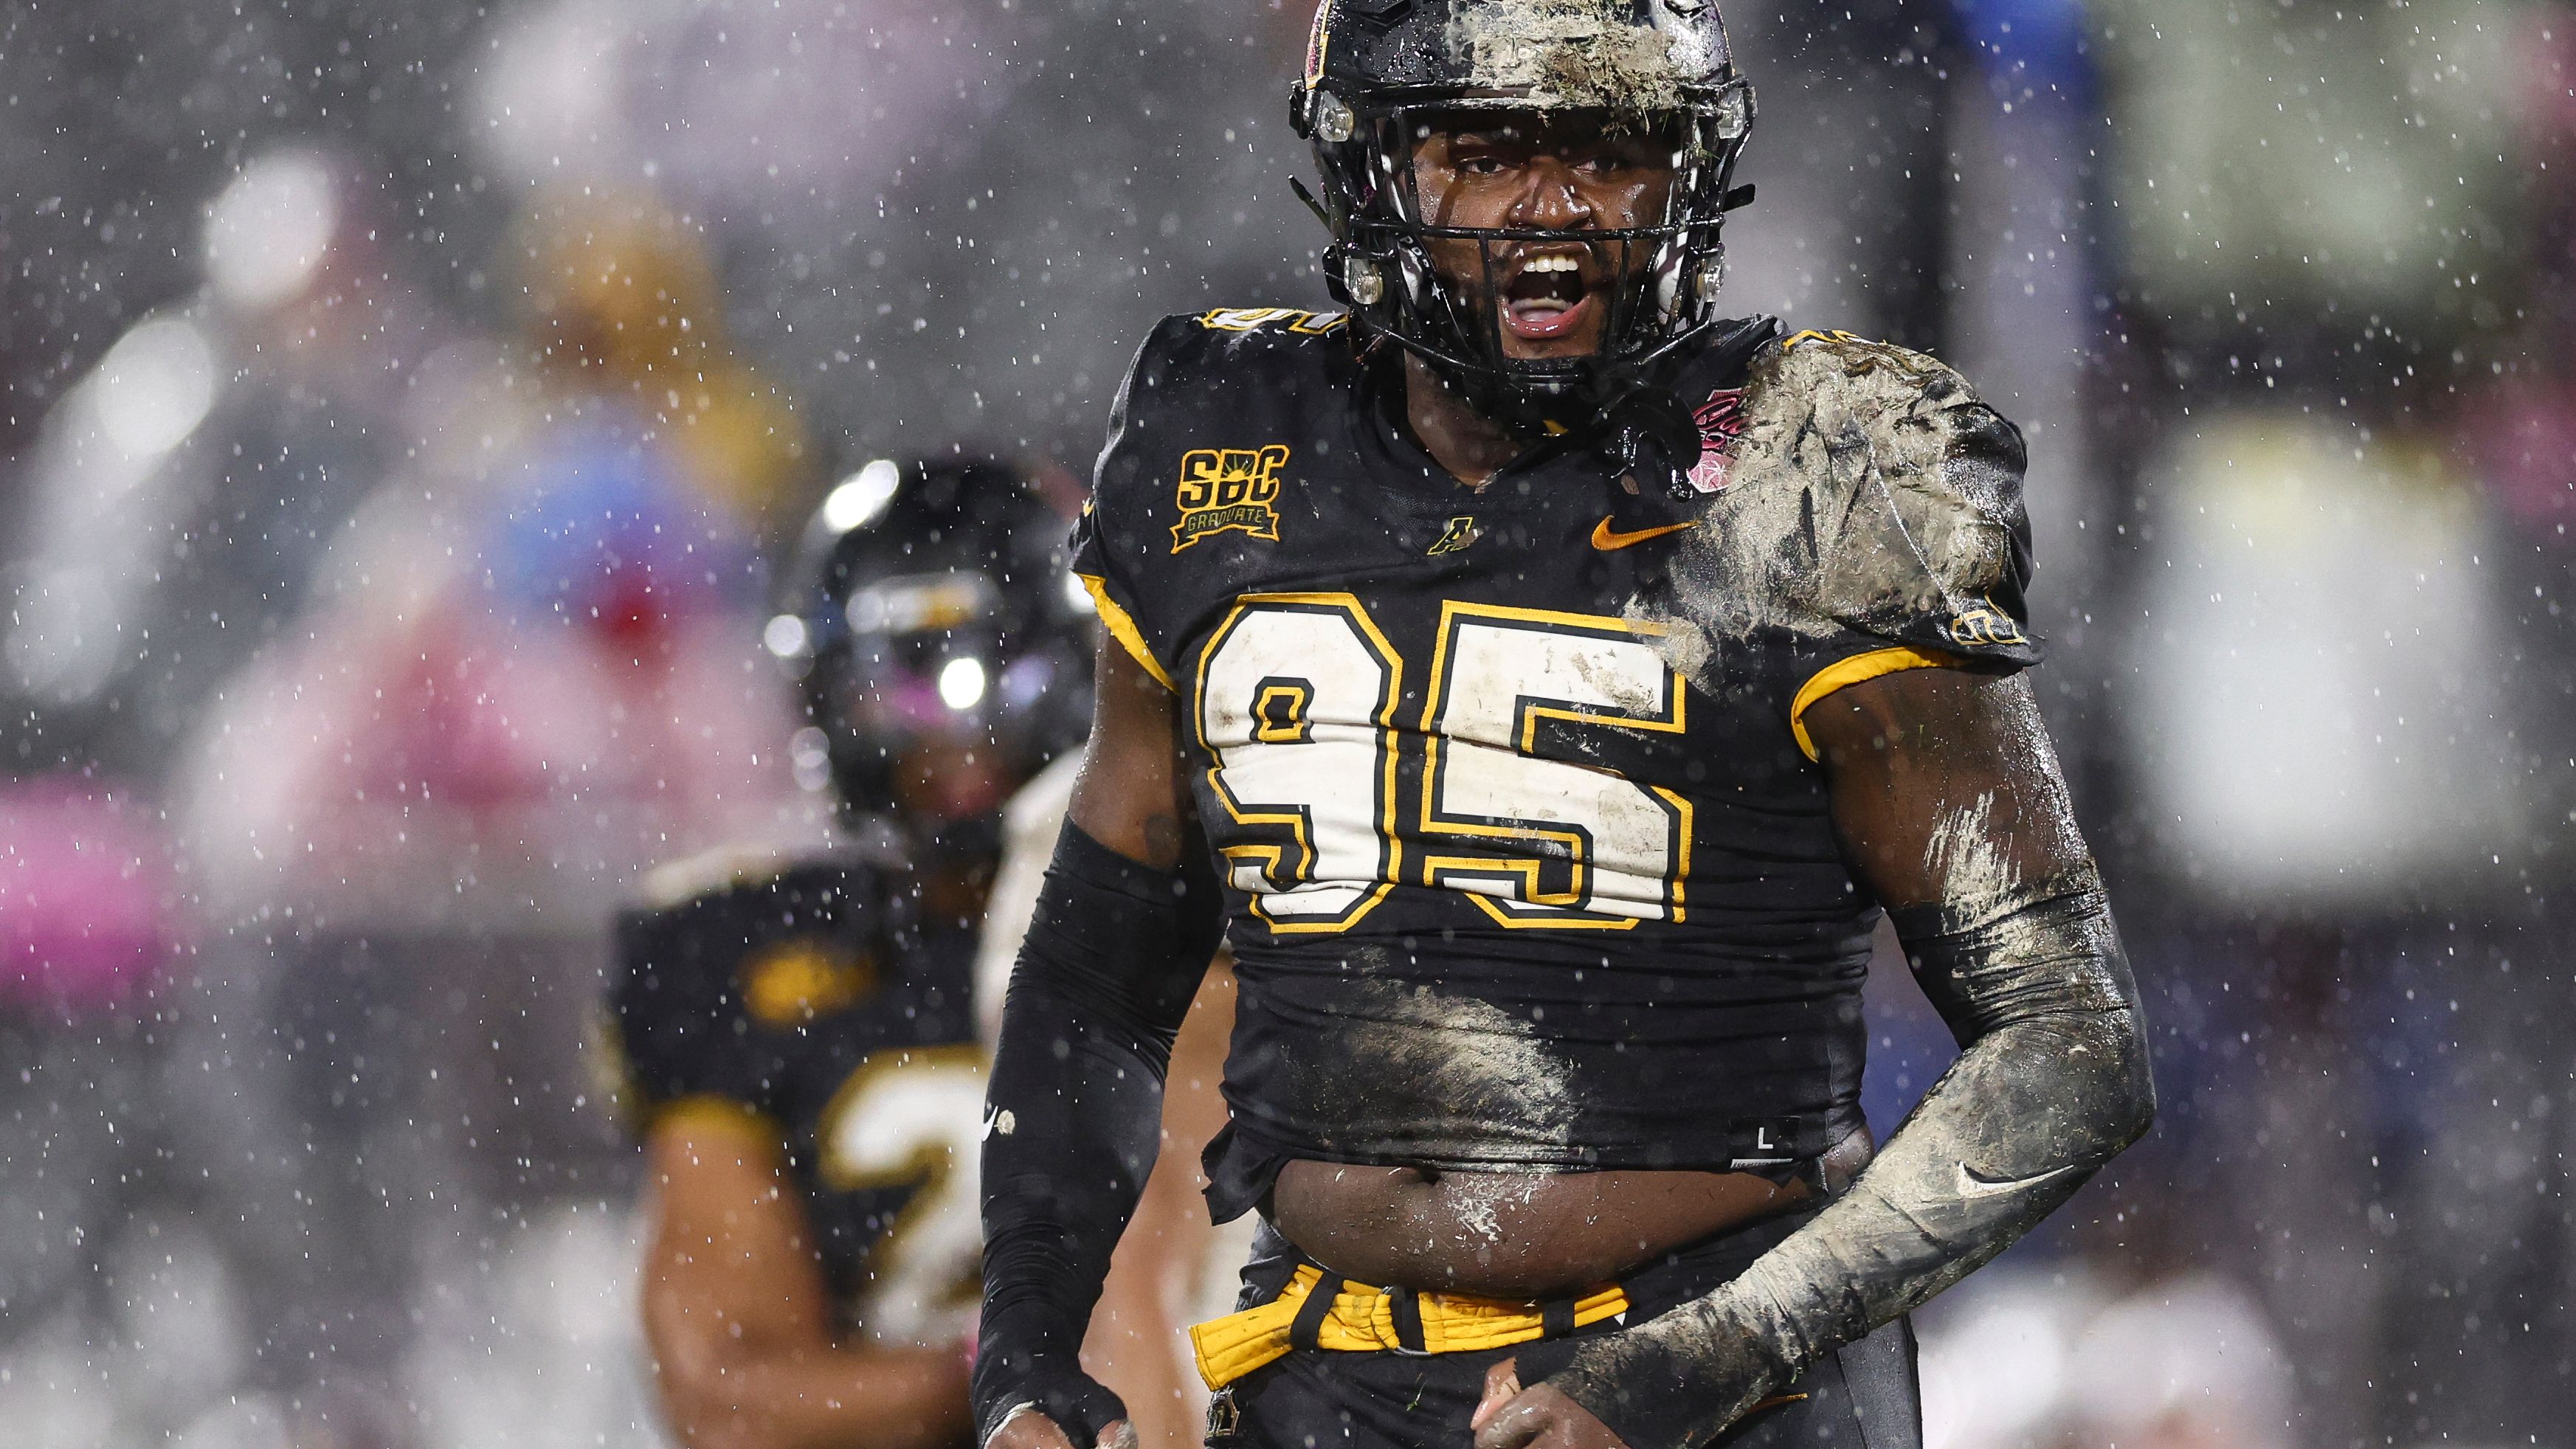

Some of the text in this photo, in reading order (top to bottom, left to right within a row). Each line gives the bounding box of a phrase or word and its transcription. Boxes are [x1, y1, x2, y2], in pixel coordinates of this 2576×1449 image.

[1177, 445, 1290, 511] SBC
[1187, 508, 1264, 531] GRADUATE
[1195, 592, 1693, 933] 95
[1758, 1127, 1774, 1149] L
